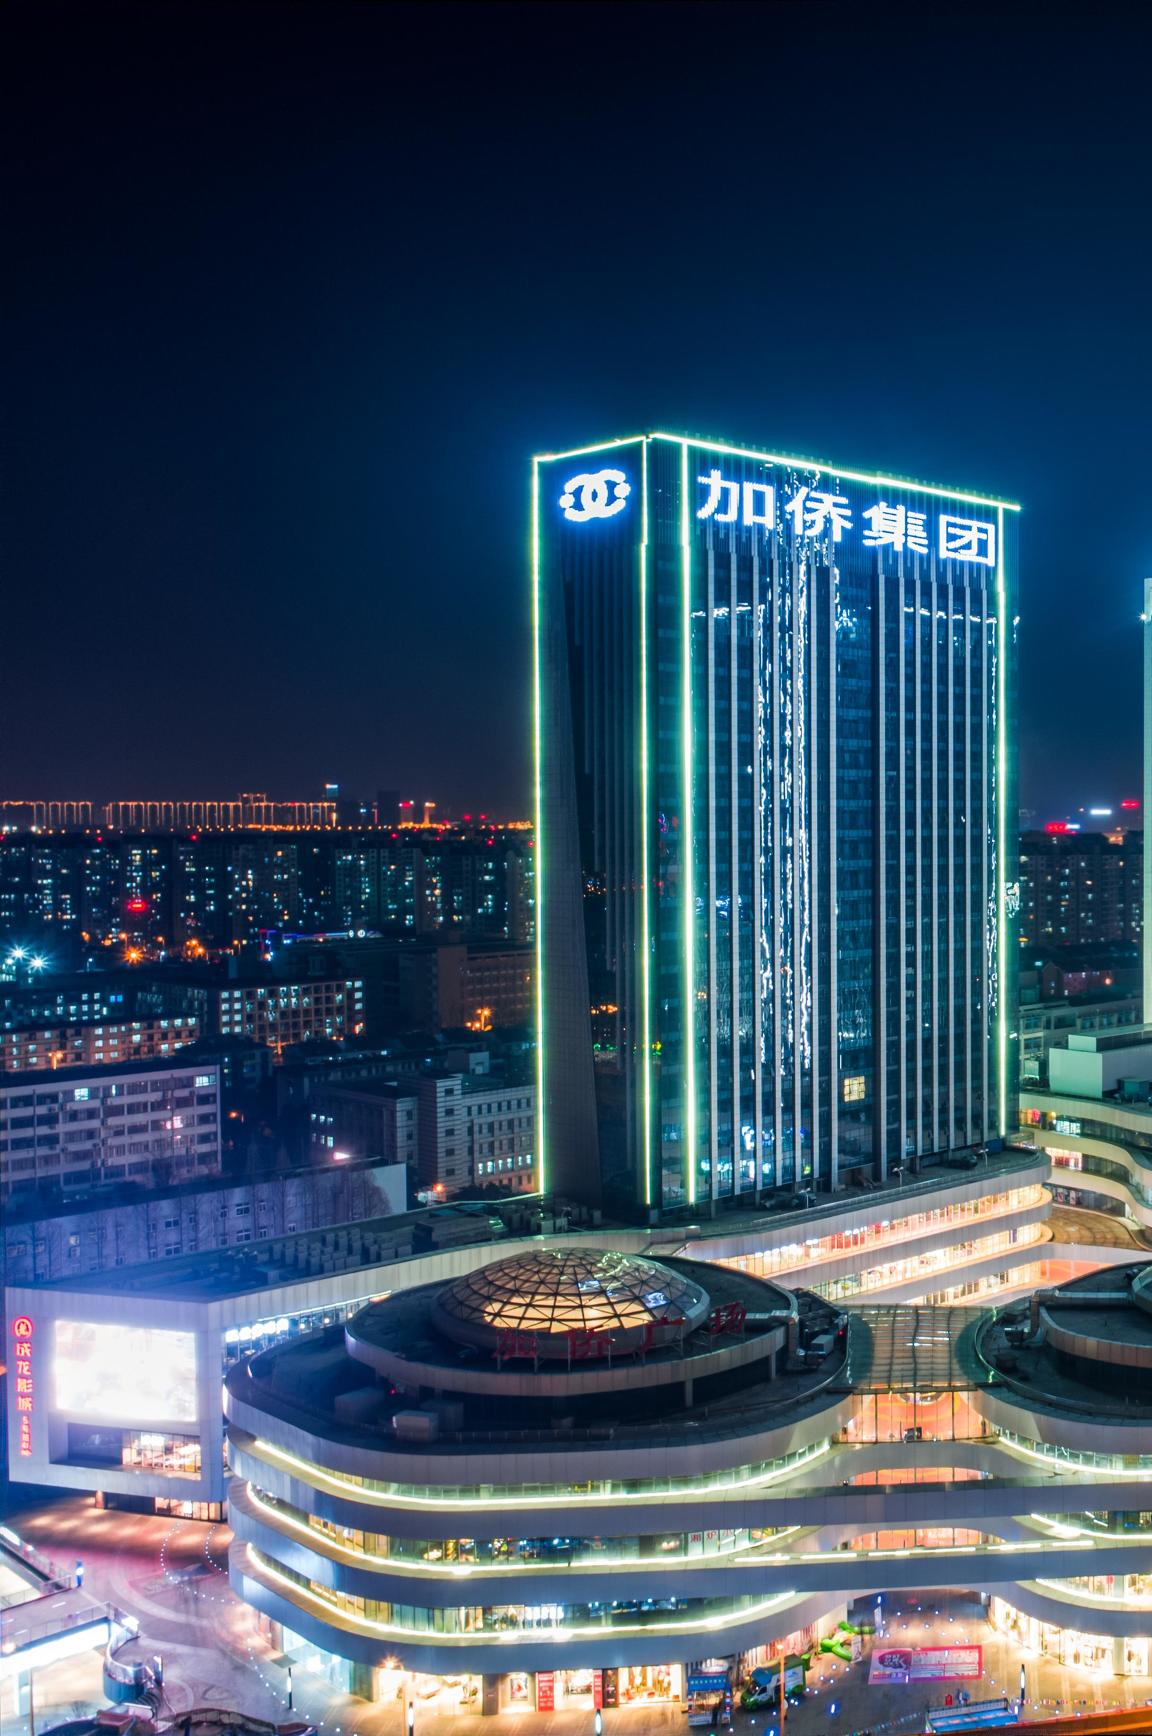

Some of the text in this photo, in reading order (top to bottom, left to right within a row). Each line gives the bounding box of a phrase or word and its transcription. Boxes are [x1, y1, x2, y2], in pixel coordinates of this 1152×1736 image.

[697, 469, 996, 566] 加侨集团
[15, 1342, 33, 1411] 成龙影城
